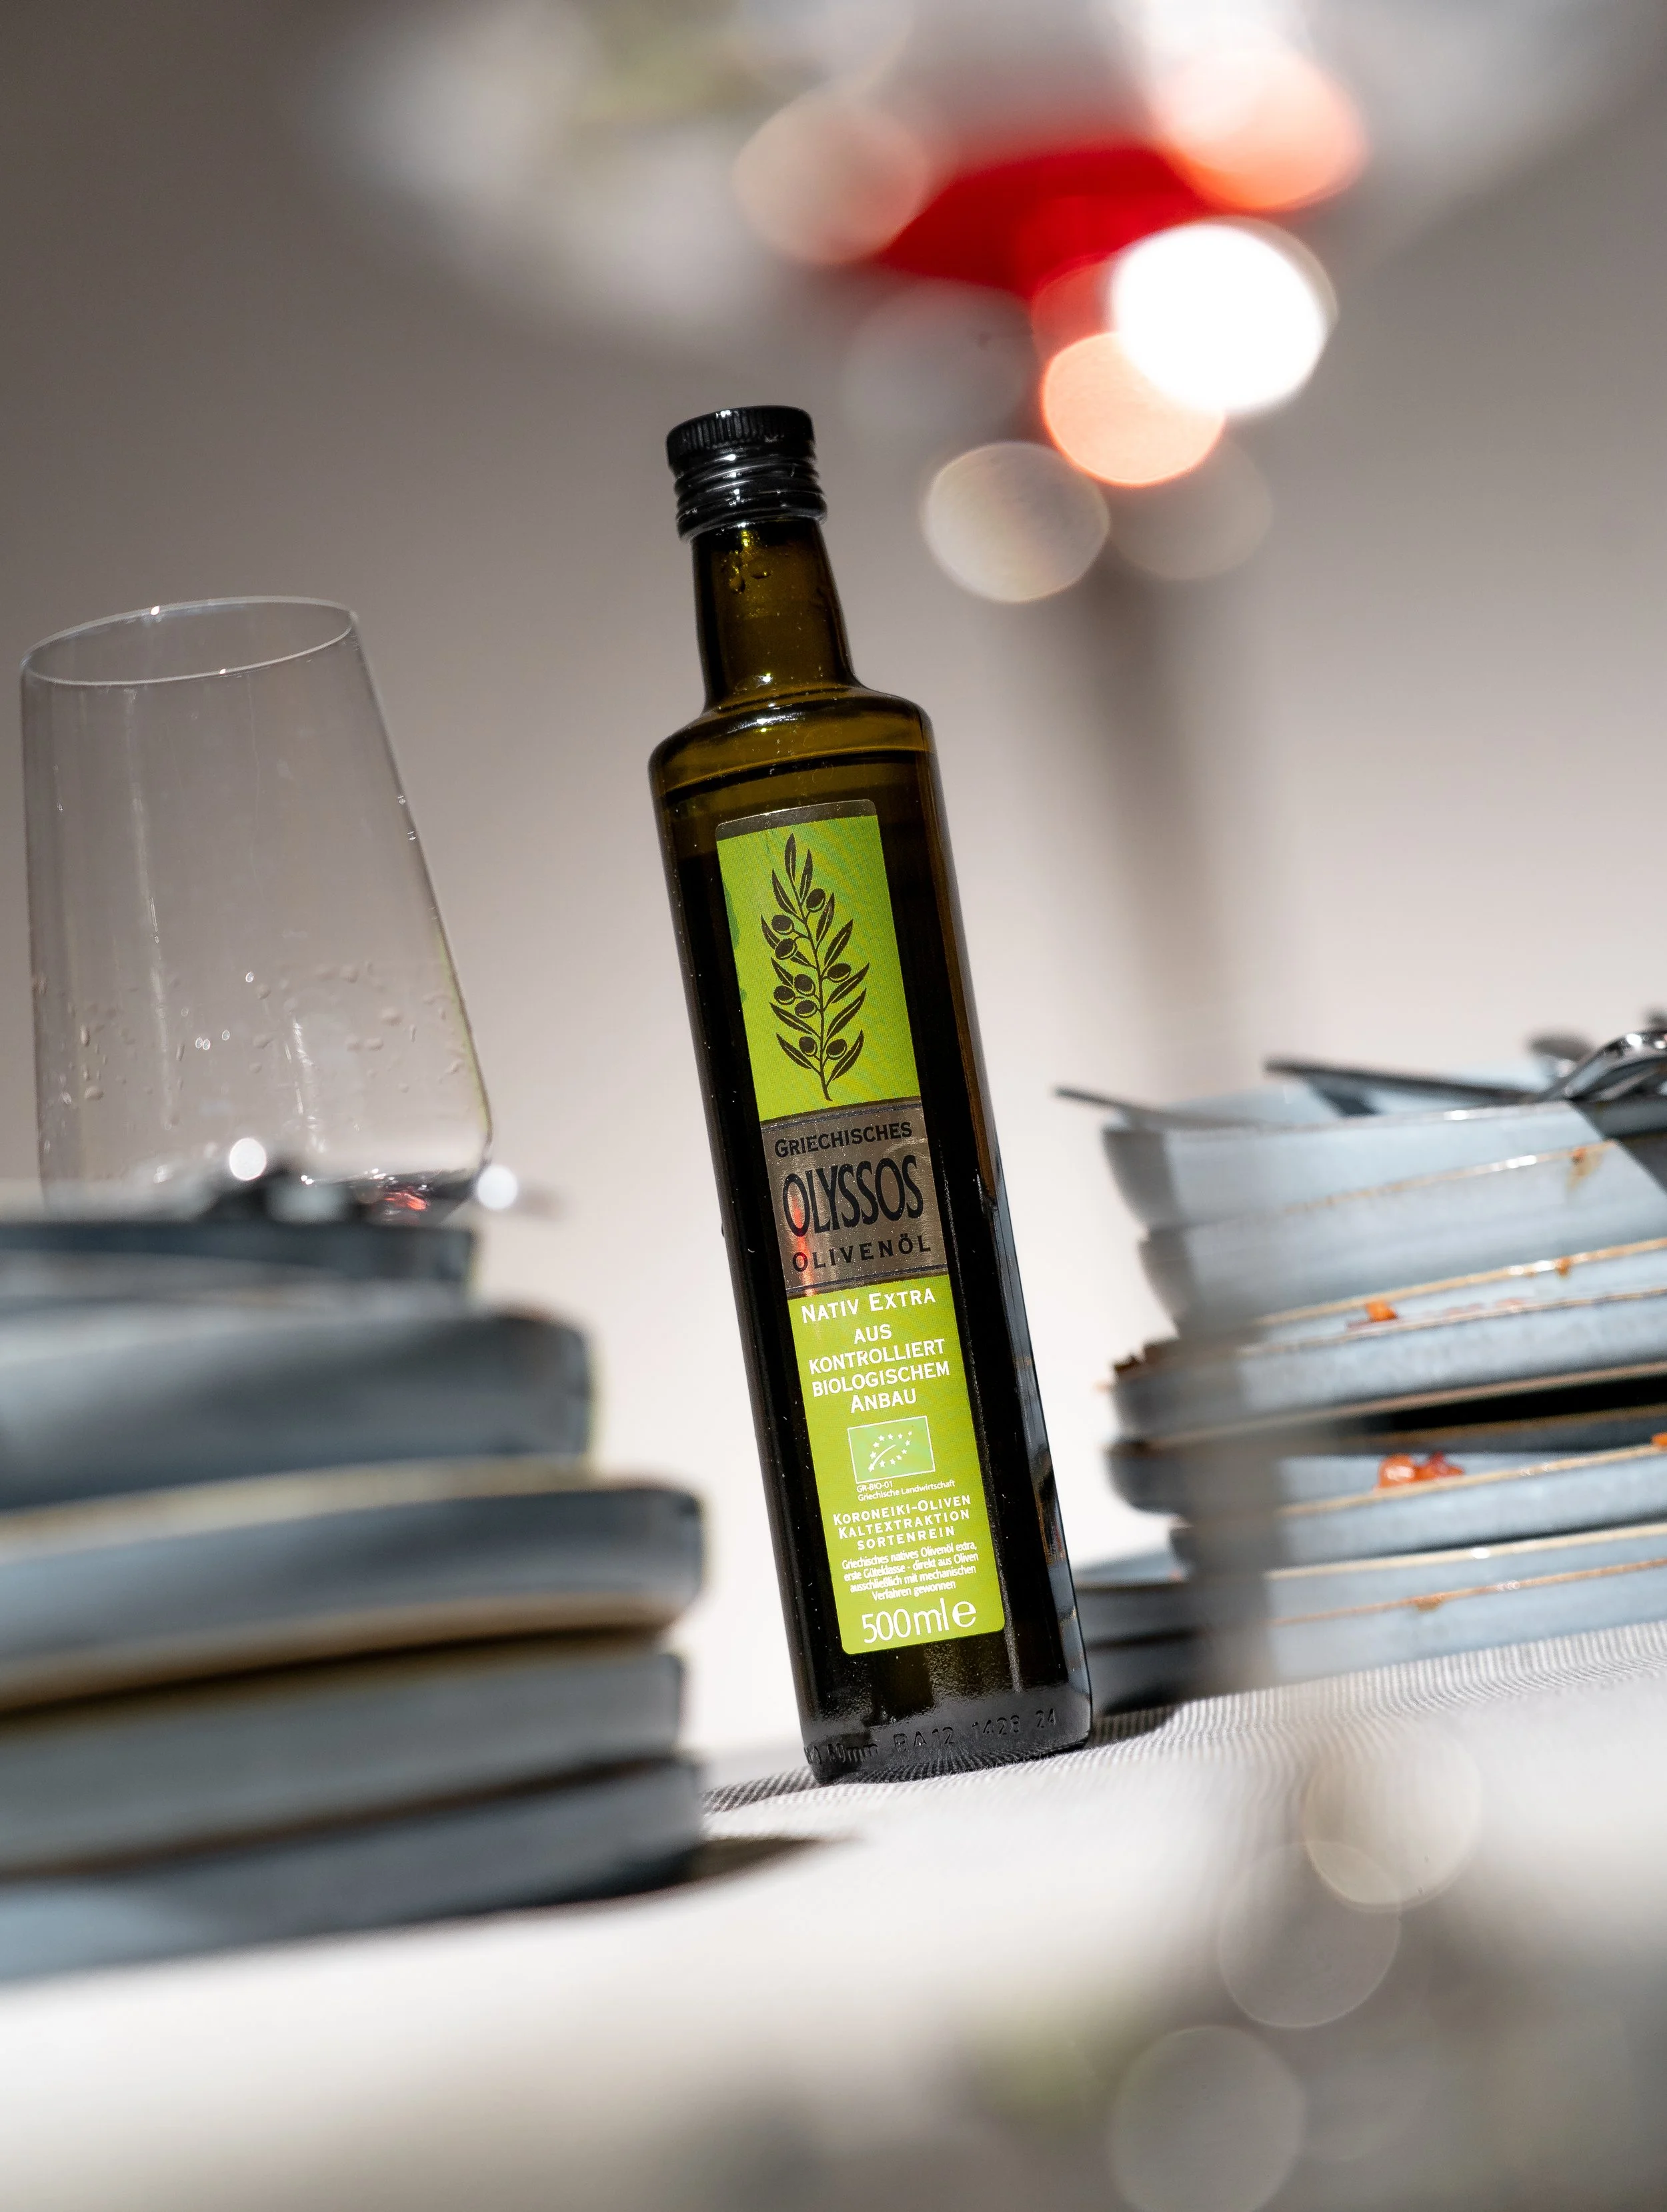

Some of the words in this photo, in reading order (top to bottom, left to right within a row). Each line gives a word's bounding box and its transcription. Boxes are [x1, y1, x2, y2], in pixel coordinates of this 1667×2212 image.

[775, 1121, 913, 1158] GRIECHISCHES
[783, 1155, 924, 1237] OLYSSOS
[792, 1233, 931, 1272] OLIVENÖL
[801, 1299, 859, 1323] NATIV
[869, 1287, 936, 1312] EXTRA
[854, 1323, 892, 1345] AUS
[808, 1338, 945, 1375] KONTROLLIERT
[811, 1361, 950, 1397] BIOLOGISCHEM
[851, 1388, 917, 1413] ANBAU
[856, 1480, 893, 1493] GR-BIO-01
[858, 1489, 900, 1501] Griechische
[902, 1479, 956, 1495] Landwirtschaft
[833, 1494, 971, 1526] KORONEIKI-OLIVEN
[838, 1509, 970, 1539] KALTEXTRAKTION
[857, 1525, 955, 1551] SORTENREIN
[842, 1555, 890, 1570] Griechisches
[890, 1549, 919, 1562] natives
[920, 1542, 954, 1557] Olivenöl
[956, 1541, 978, 1552] extra,
[844, 1571, 862, 1581] erste
[864, 1564, 906, 1579] Güteklasse
[912, 1558, 937, 1571] direkt
[938, 1557, 953, 1567] aus
[954, 1553, 979, 1564] Oliven
[850, 1575, 903, 1593] ausschließlich
[904, 1573, 919, 1584] mit
[920, 1565, 977, 1582] mechanischen
[872, 1587, 912, 1601] Verfahren
[914, 1581, 956, 1597] gewonnen
